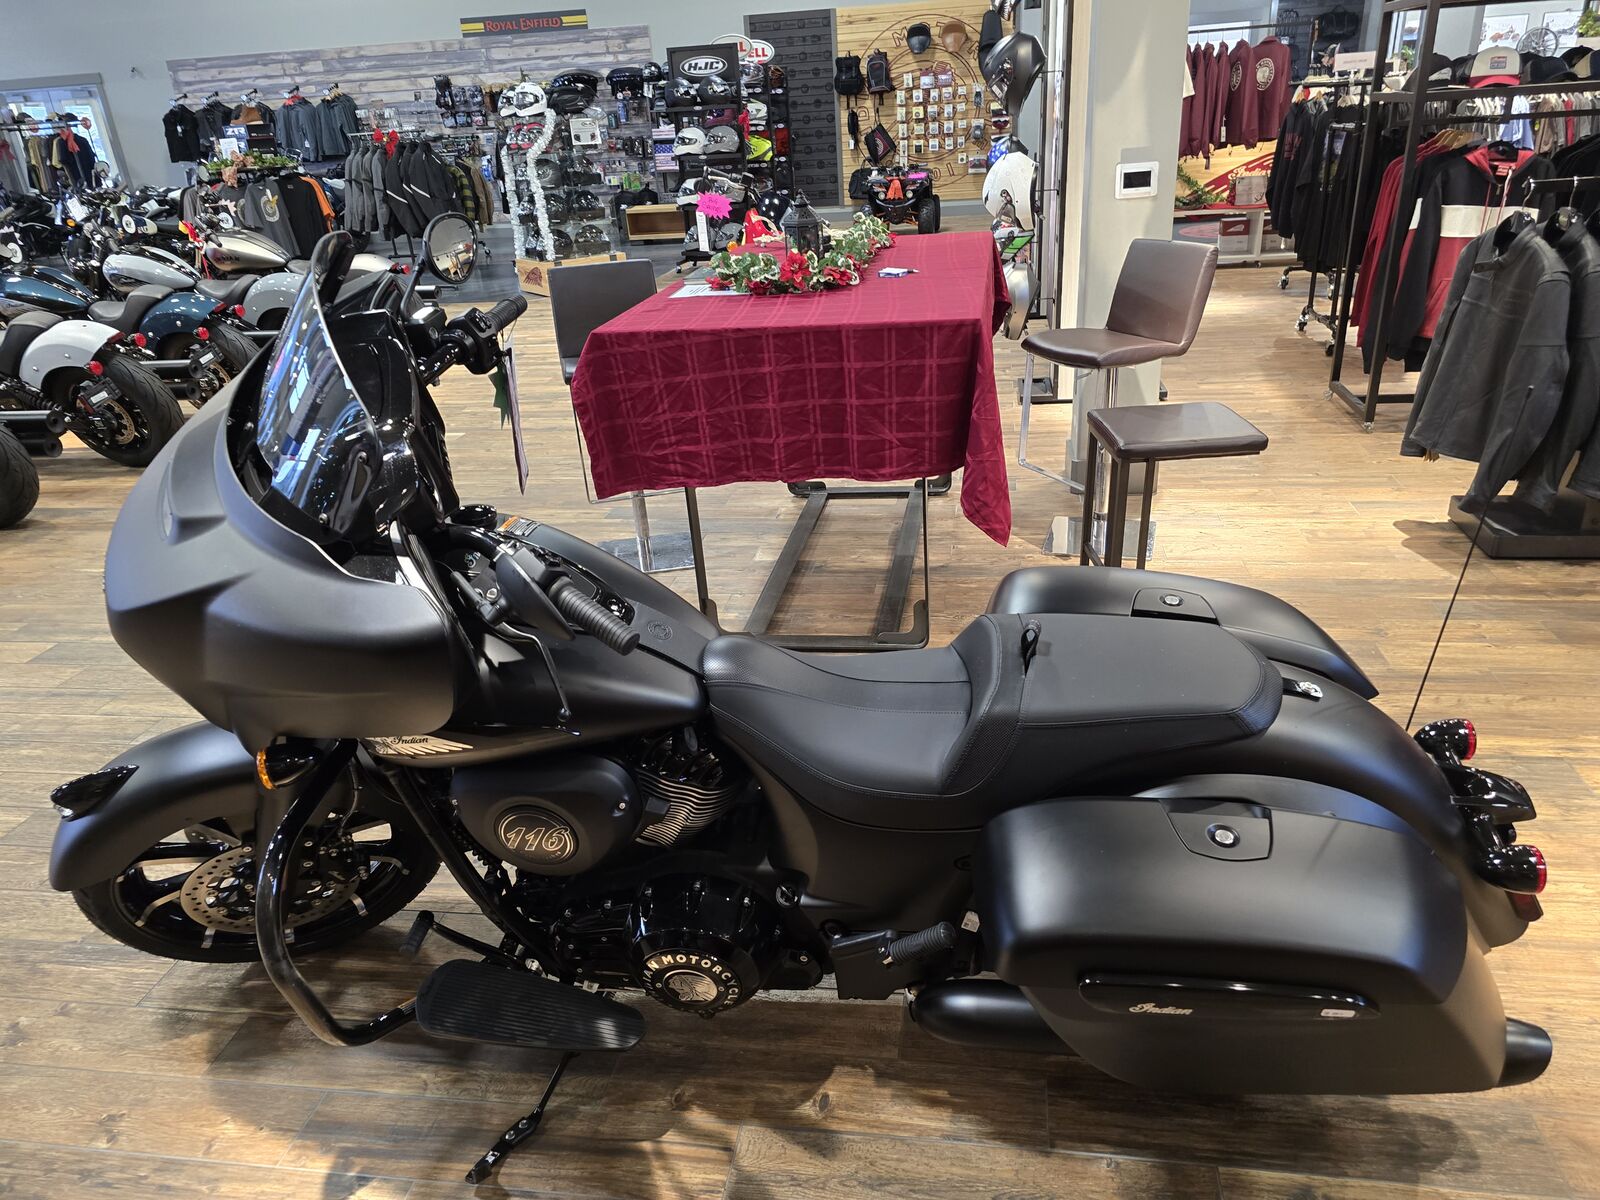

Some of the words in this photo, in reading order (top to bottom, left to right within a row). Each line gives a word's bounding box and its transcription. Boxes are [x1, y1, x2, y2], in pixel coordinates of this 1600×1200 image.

[485, 20, 518, 32] ROYAL
[520, 17, 561, 30] ENFIELD
[748, 47, 768, 58] ELL
[687, 61, 720, 72] HJC
[390, 736, 428, 745] Indian
[506, 827, 570, 851] 116
[661, 954, 739, 1006] MOTORCYCLE
[1129, 1002, 1193, 1016] Indian
